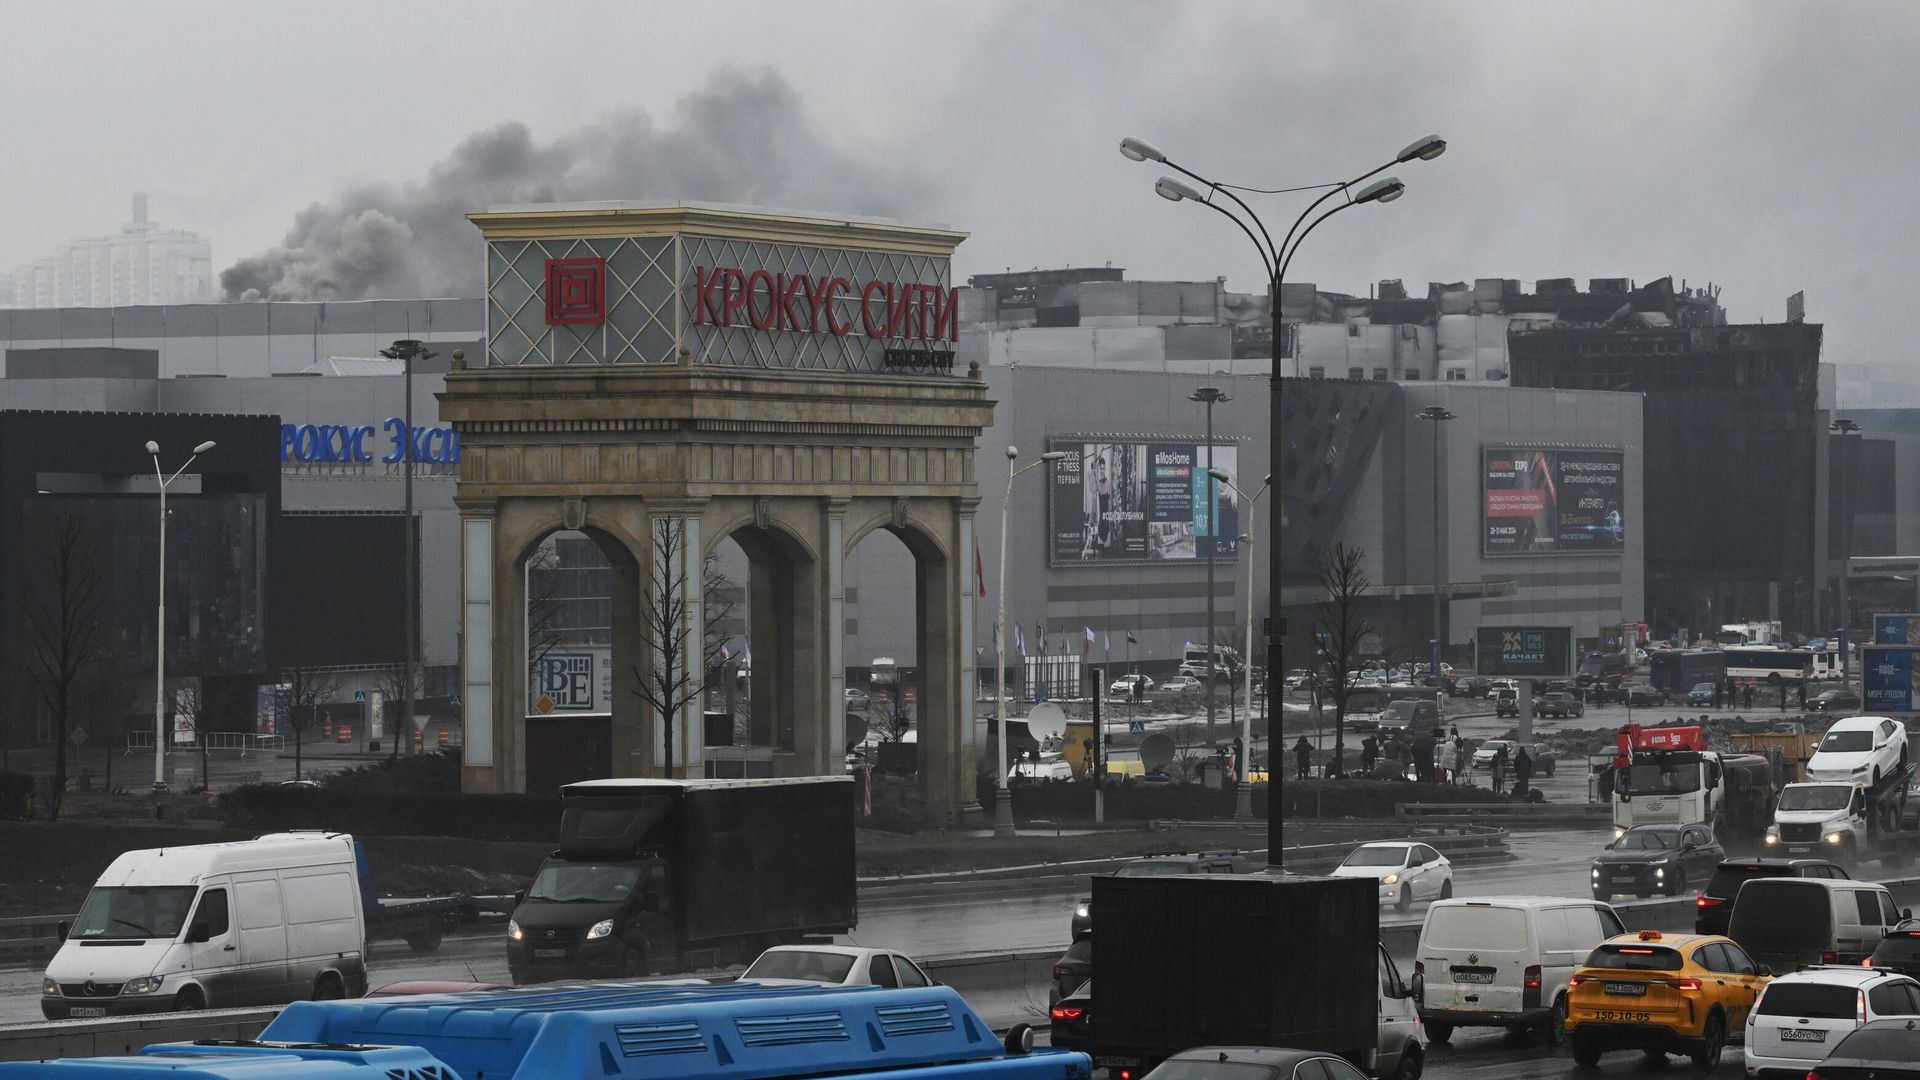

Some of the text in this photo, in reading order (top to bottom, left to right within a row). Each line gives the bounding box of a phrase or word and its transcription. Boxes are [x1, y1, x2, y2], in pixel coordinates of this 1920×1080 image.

[696, 266, 958, 342] КРОКУС СИТИ
[1596, 1011, 1650, 1021] 150-10-05
